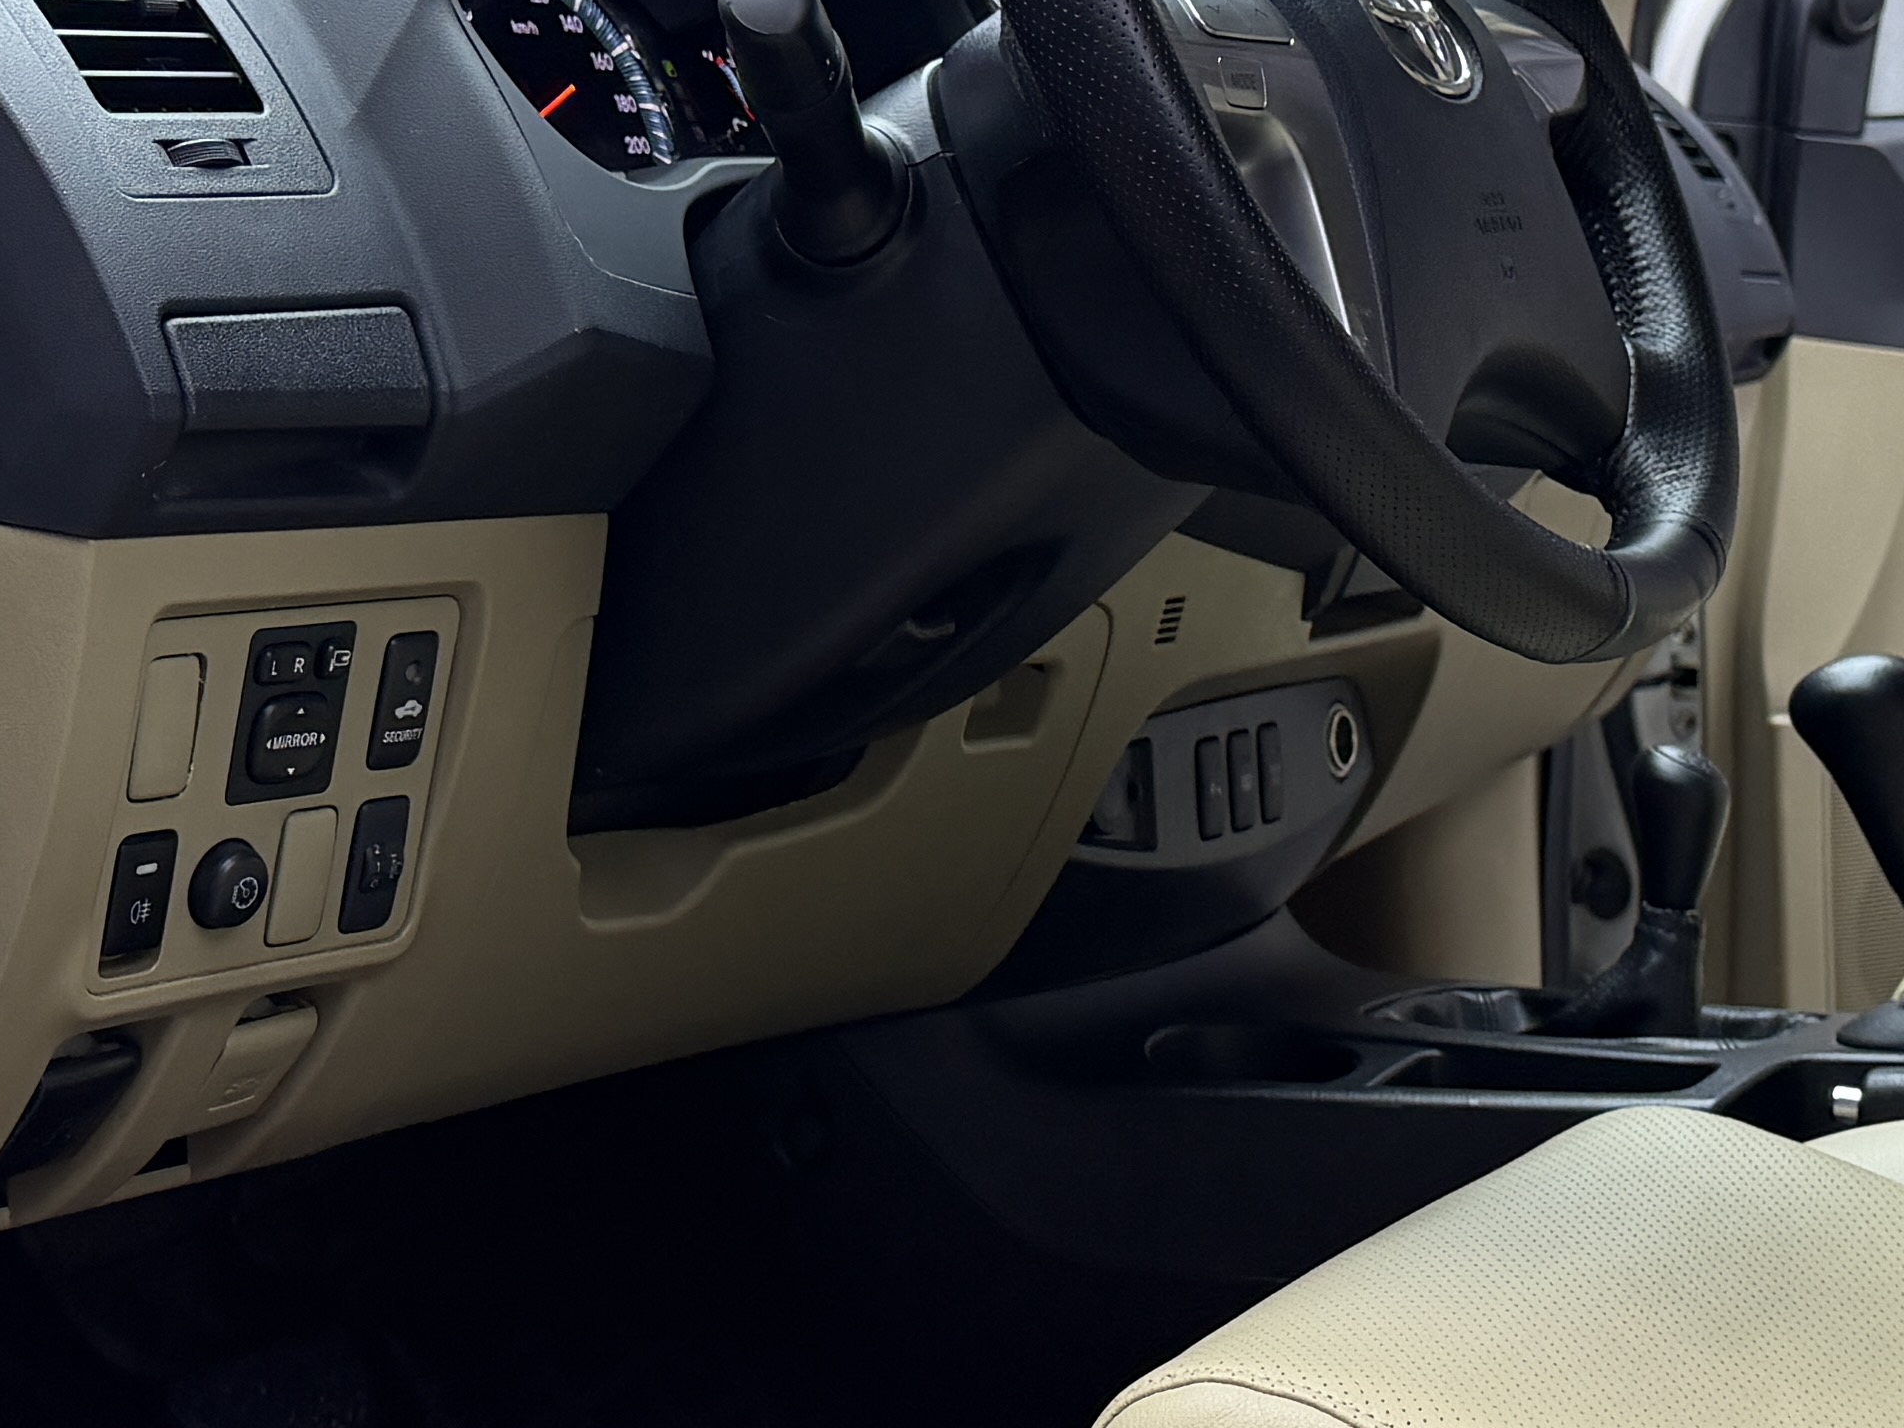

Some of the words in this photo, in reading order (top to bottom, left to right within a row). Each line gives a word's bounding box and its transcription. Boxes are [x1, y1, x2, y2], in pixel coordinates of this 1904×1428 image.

[558, 14, 584, 34] 140
[590, 52, 615, 71] 160
[613, 93, 638, 114] 180
[624, 135, 651, 155] 200
[271, 660, 278, 676] L
[294, 657, 305, 674] R
[272, 732, 319, 750] MIRROR
[382, 727, 424, 744] SECURITY
